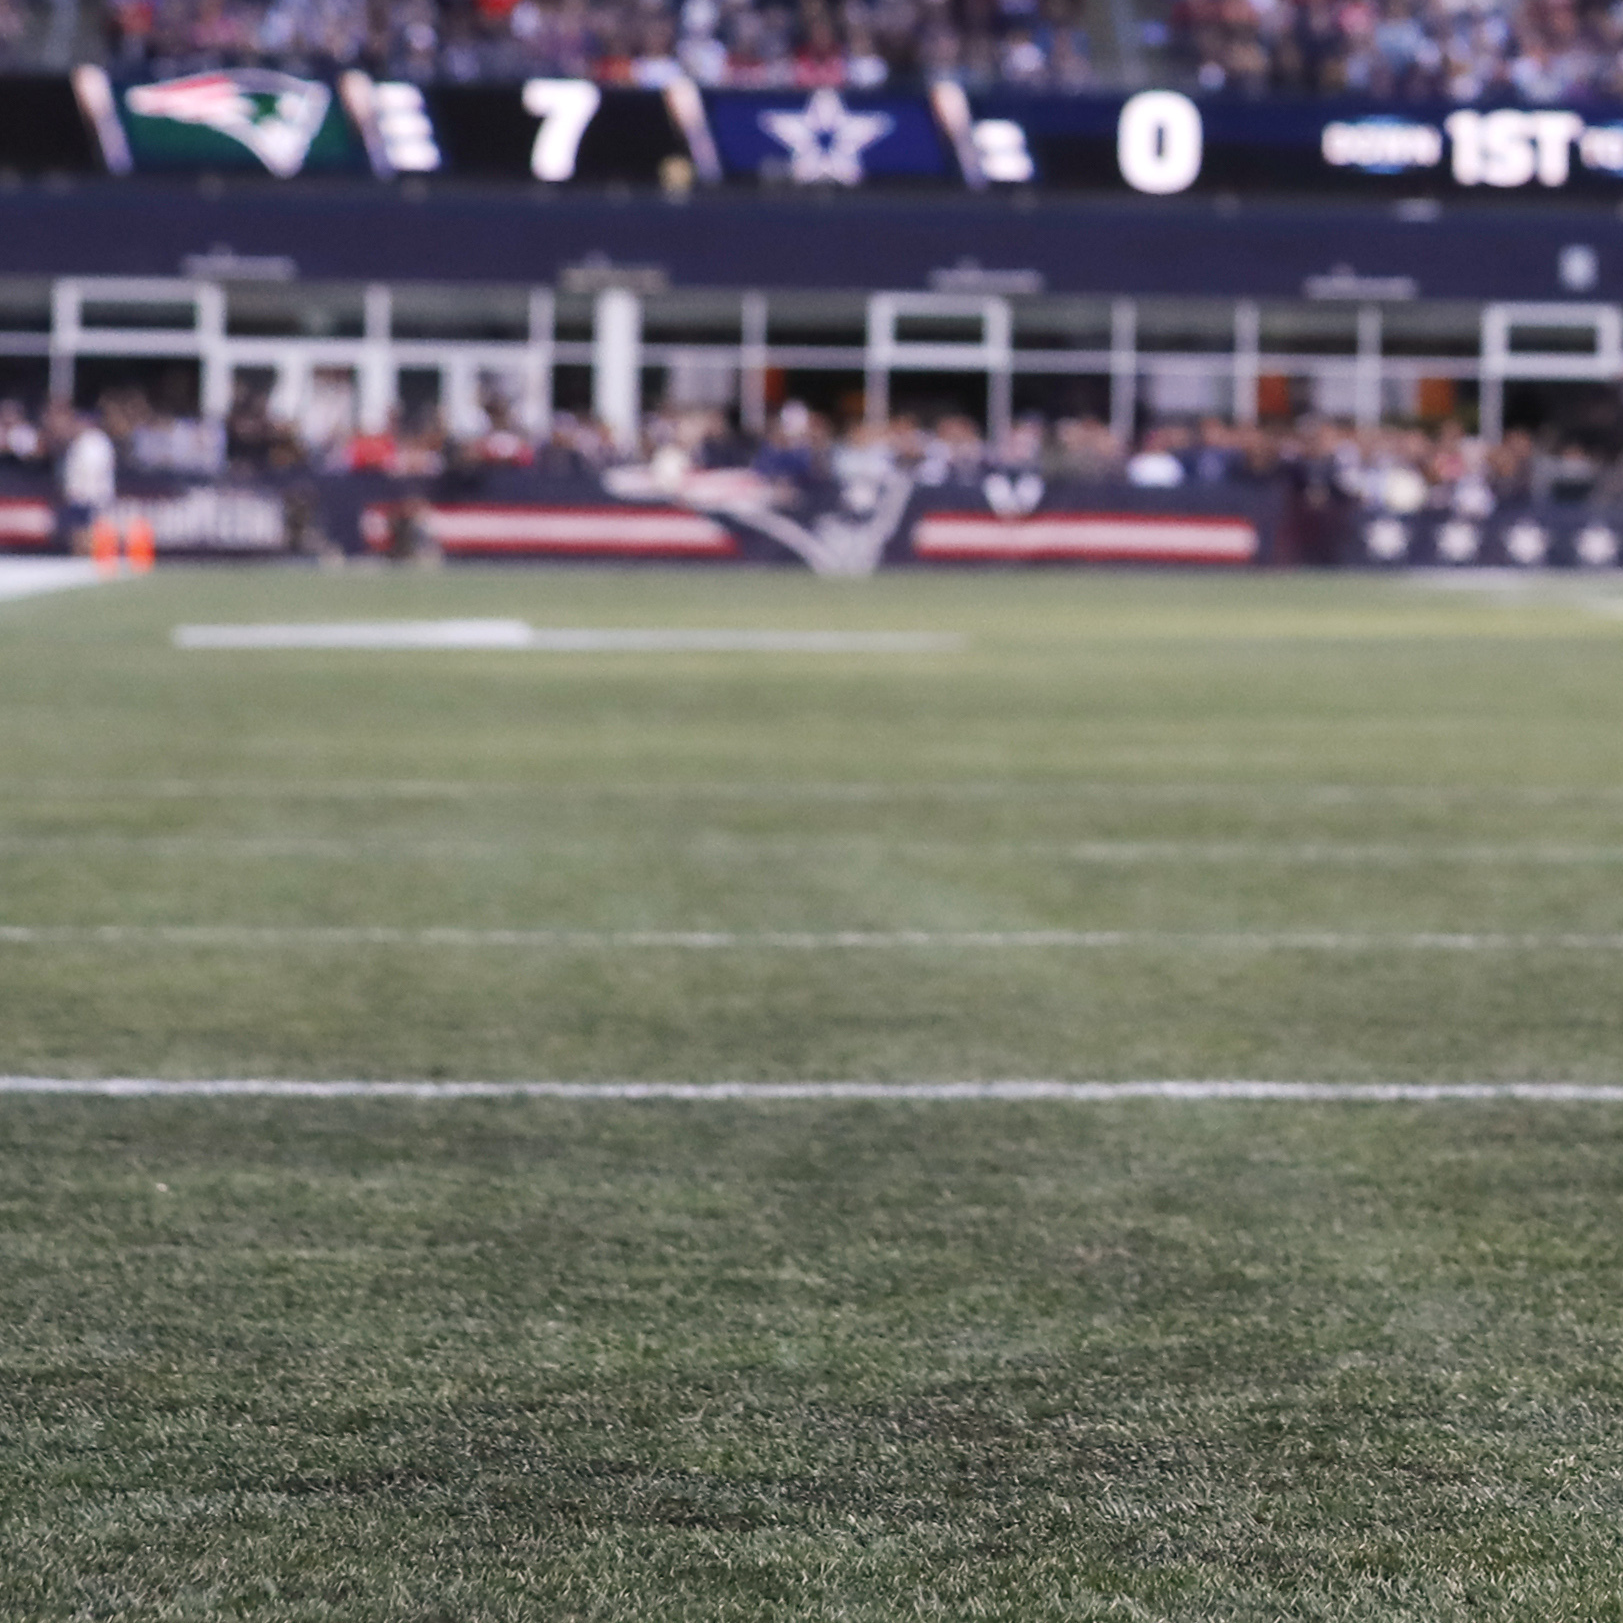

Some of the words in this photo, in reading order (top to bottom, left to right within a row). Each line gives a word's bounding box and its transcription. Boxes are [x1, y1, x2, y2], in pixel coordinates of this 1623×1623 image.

[521, 77, 601, 182] 7
[1117, 88, 1202, 196] 0
[1443, 108, 1585, 189] 1ST
